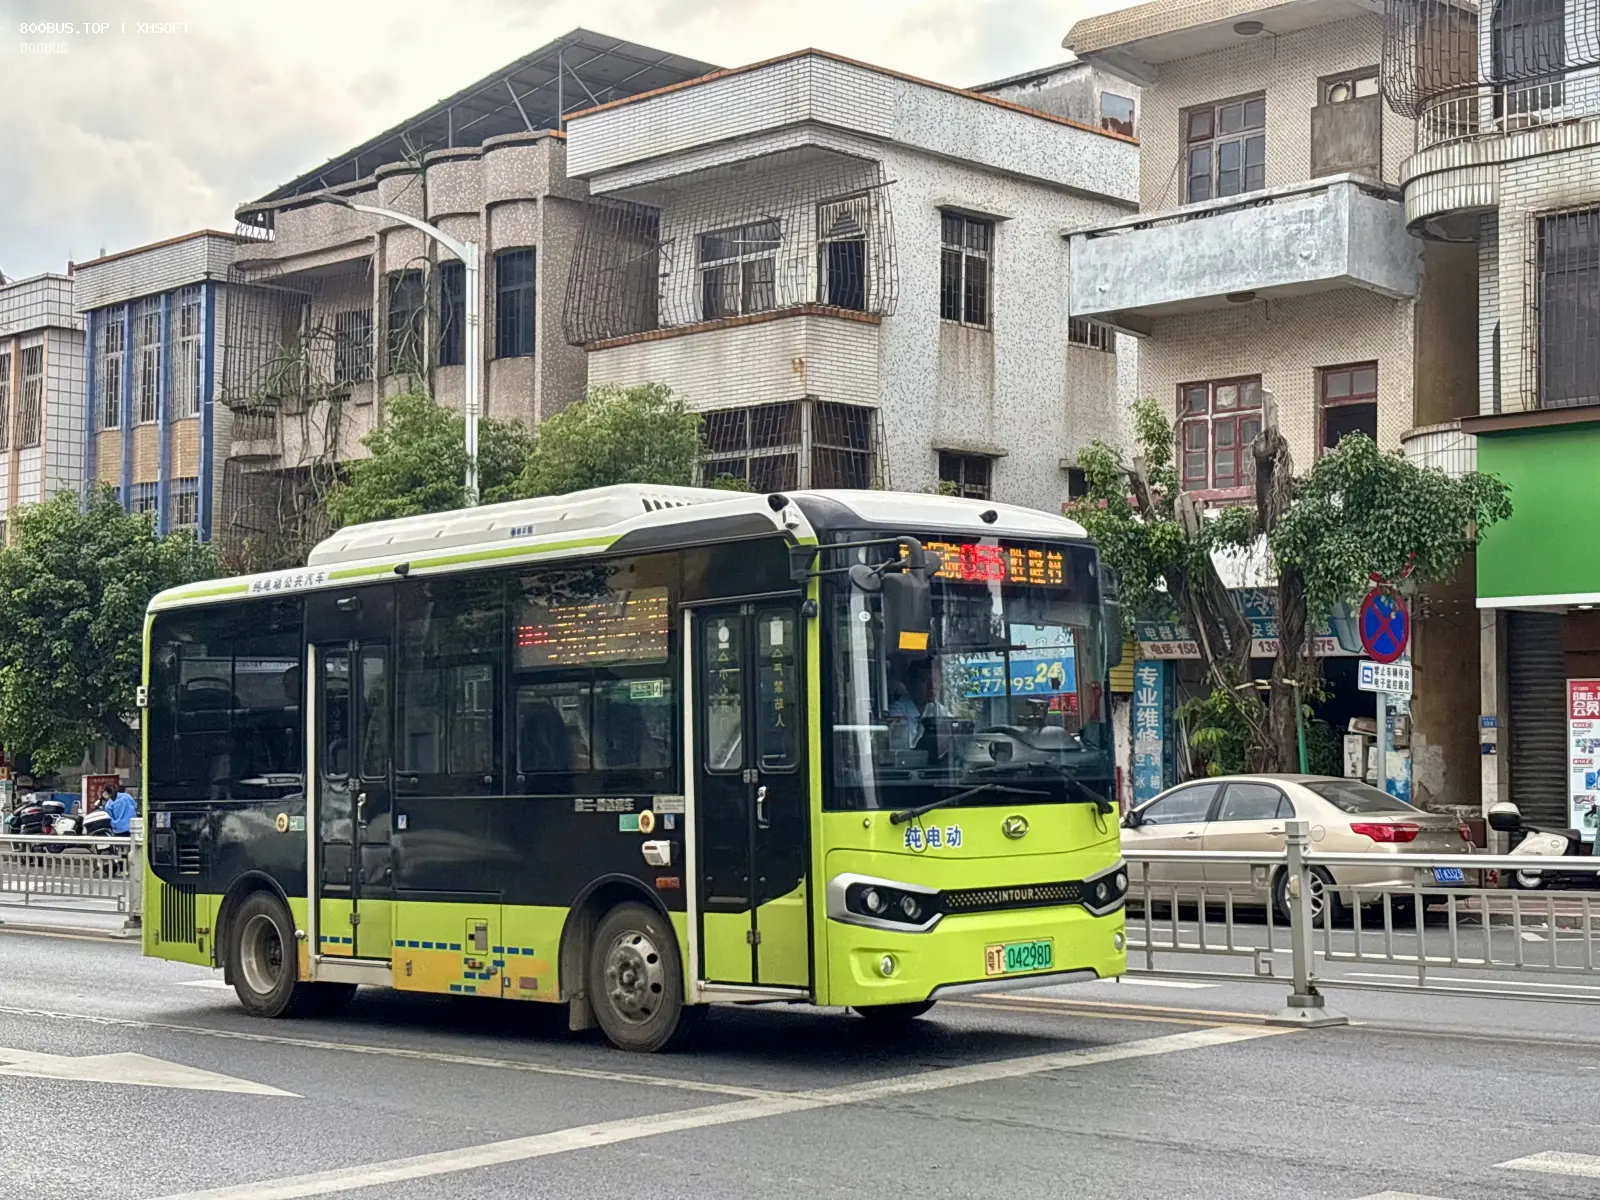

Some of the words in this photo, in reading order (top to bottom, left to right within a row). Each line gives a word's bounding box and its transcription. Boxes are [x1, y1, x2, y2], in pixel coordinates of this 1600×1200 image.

[252, 571, 326, 593] 纯电动公共汽车
[1136, 666, 1160, 741] 专业维修
[904, 825, 962, 849] 纯电动
[998, 888, 1034, 901] INTOUR
